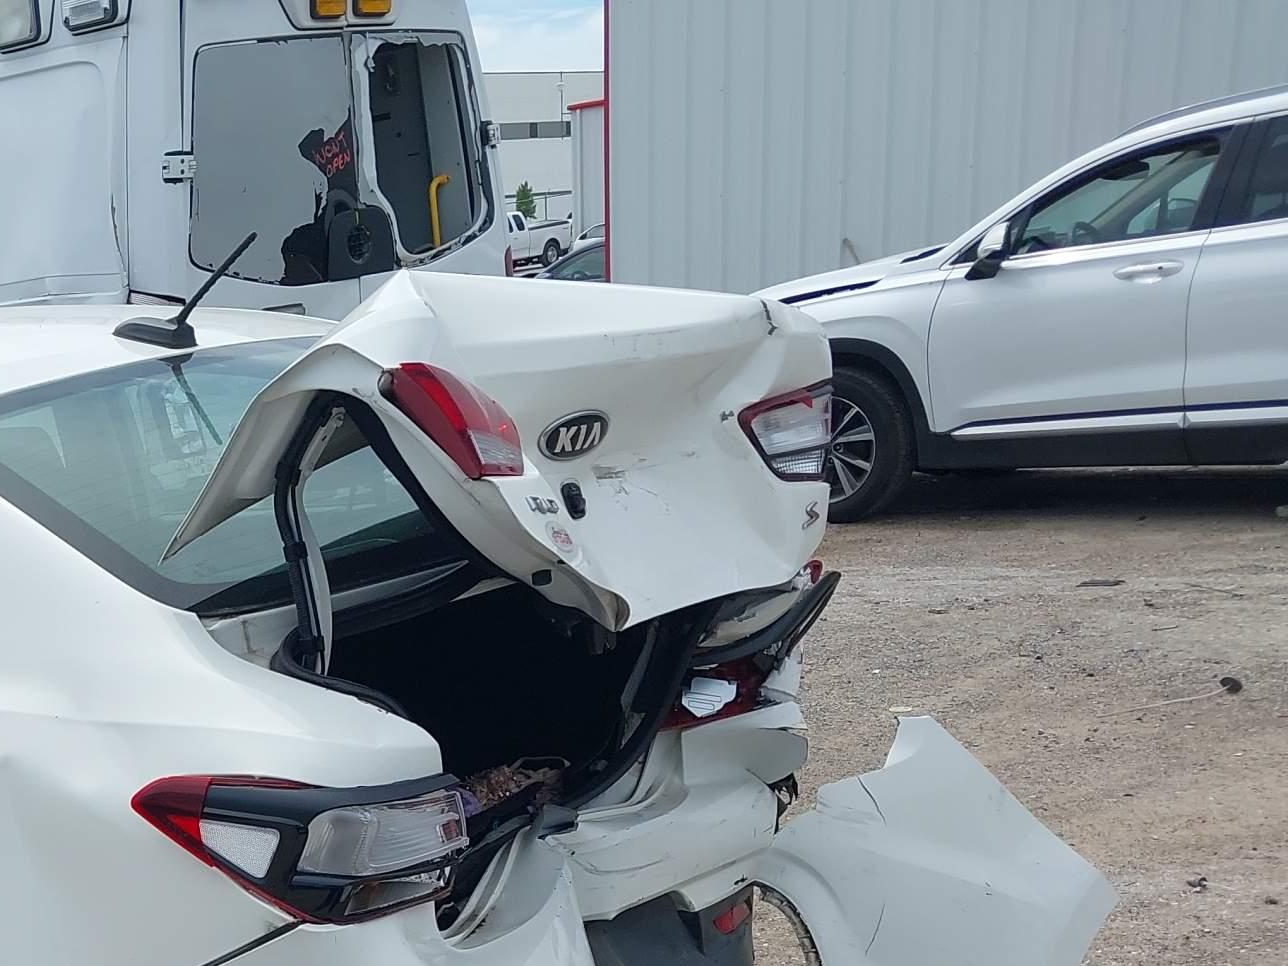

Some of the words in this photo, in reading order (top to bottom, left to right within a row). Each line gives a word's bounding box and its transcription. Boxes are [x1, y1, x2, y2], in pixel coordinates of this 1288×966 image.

[327, 149, 351, 178] OPEN
[554, 421, 601, 453] KIA
[801, 501, 820, 530] S
